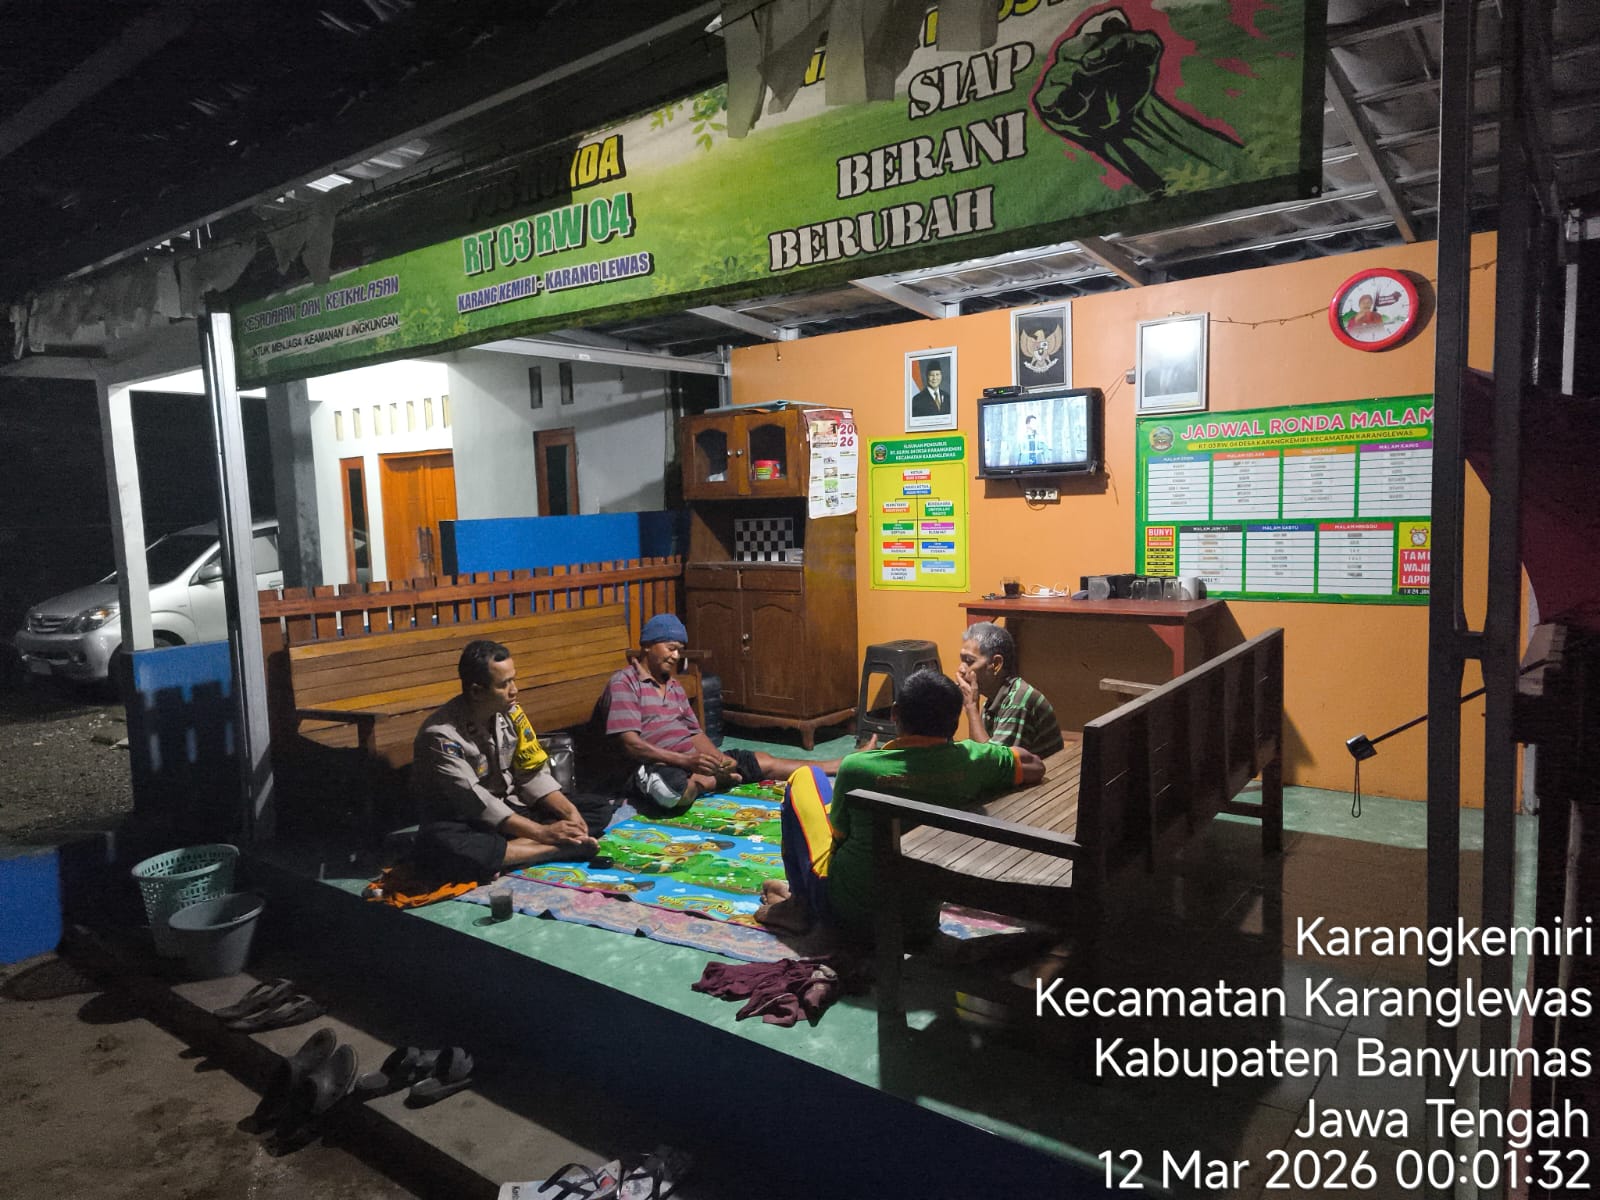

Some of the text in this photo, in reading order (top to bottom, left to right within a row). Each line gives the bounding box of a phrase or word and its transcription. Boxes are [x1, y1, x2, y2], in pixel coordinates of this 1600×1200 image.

[908, 41, 1034, 120] SIAP
[837, 109, 1027, 200] BERANI
[462, 192, 633, 275] RT 03 RW 04
[768, 184, 995, 272] BERUBAH
[457, 286, 498, 314] KARANG
[498, 274, 538, 303] KEMIRI
[544, 263, 600, 292] KARANG
[600, 251, 652, 281] LEWAS
[300, 298, 321, 319] DAN
[272, 338, 302, 353] MENJAGA
[304, 328, 344, 346] KEAMANAN
[346, 315, 399, 337] LINGKUNGAN
[840, 424, 853, 435] 20
[1182, 406, 1434, 440] JADWAL RONDA MALAM
[1256, 436, 1310, 447] KARANGKEMIRI
[1310, 433, 1354, 443] KECAMATAN
[1355, 429, 1413, 439] KARANGLEWAS
[840, 437, 853, 447] 26
[1148, 528, 1173, 536] BUNYI
